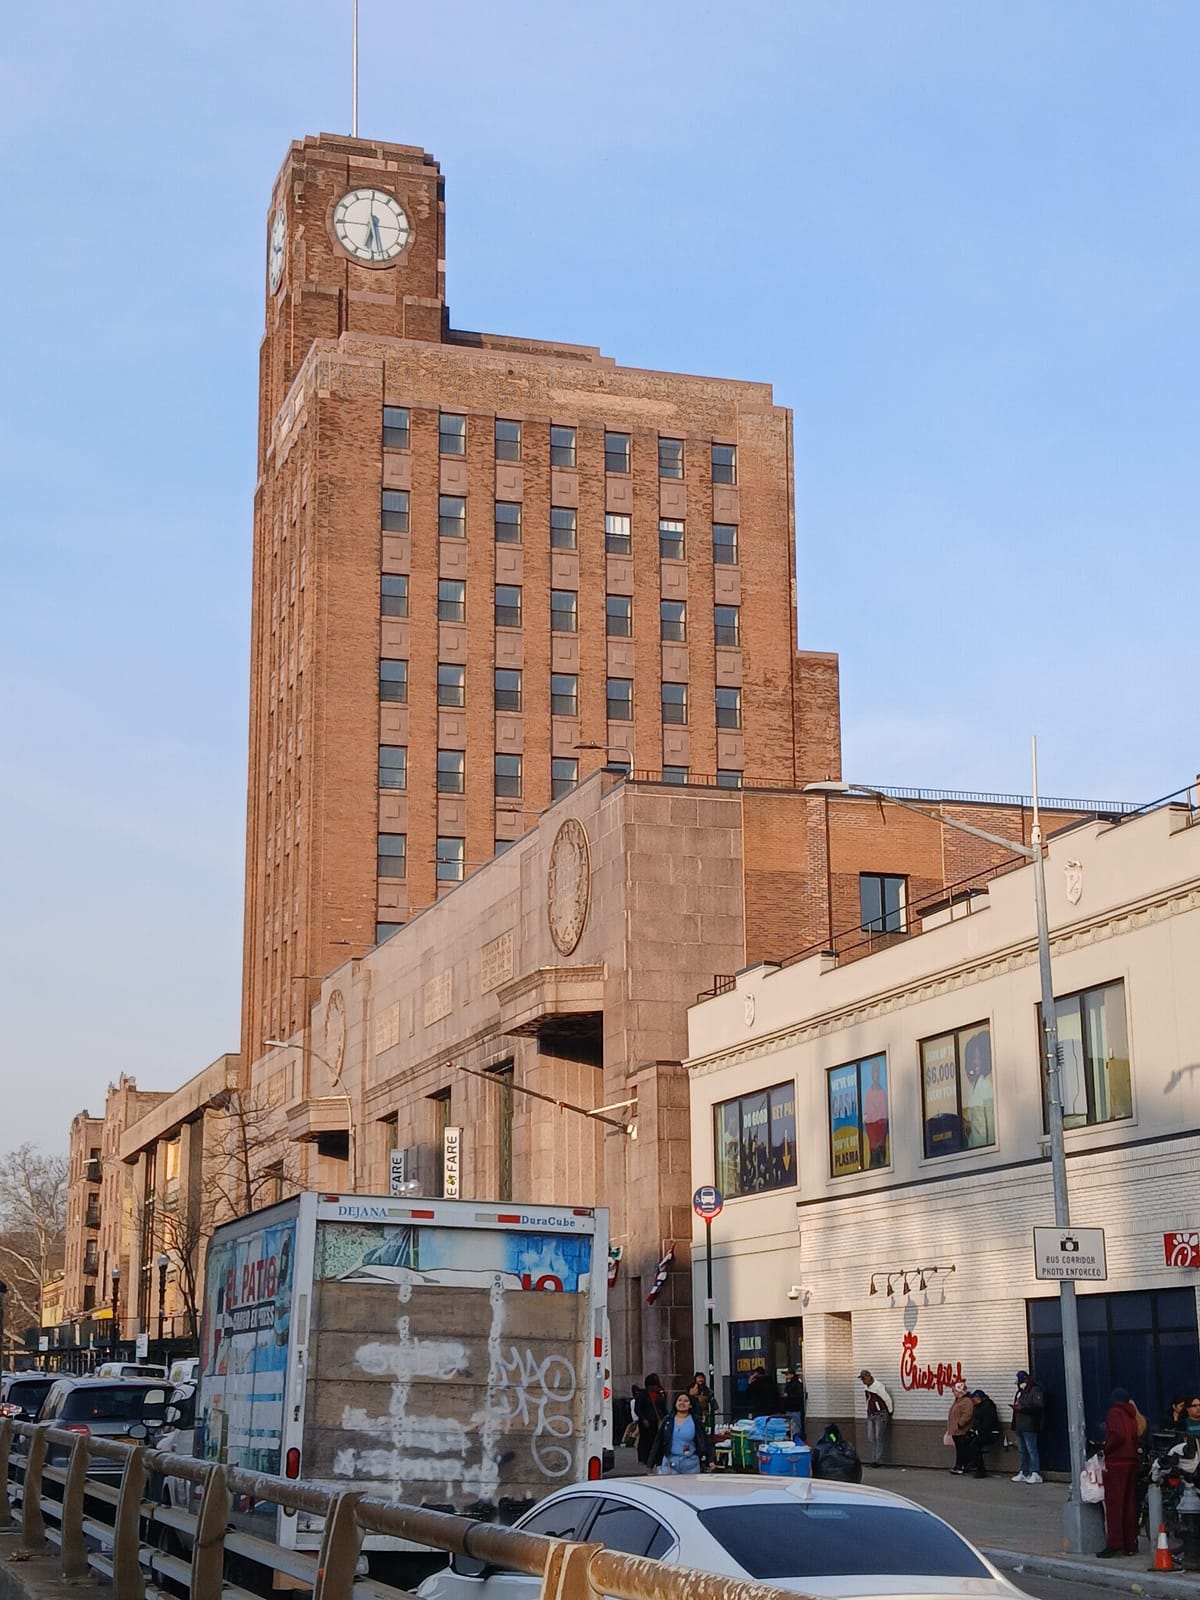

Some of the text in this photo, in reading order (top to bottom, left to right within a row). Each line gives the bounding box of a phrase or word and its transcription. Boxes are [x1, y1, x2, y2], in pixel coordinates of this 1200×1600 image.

[926, 1062, 955, 1087] $6,000
[752, 1108, 768, 1127] GOOD
[446, 1135, 458, 1174] FARE
[834, 1151, 859, 1168] PLASMA
[338, 1206, 388, 1218] DEJANA
[521, 1215, 576, 1227] DuraCube
[1045, 1255, 1096, 1265] BUS CORRIDOR
[1041, 1267, 1102, 1277] PHOTO ENFORCED
[225, 1255, 277, 1313] EL PATIO
